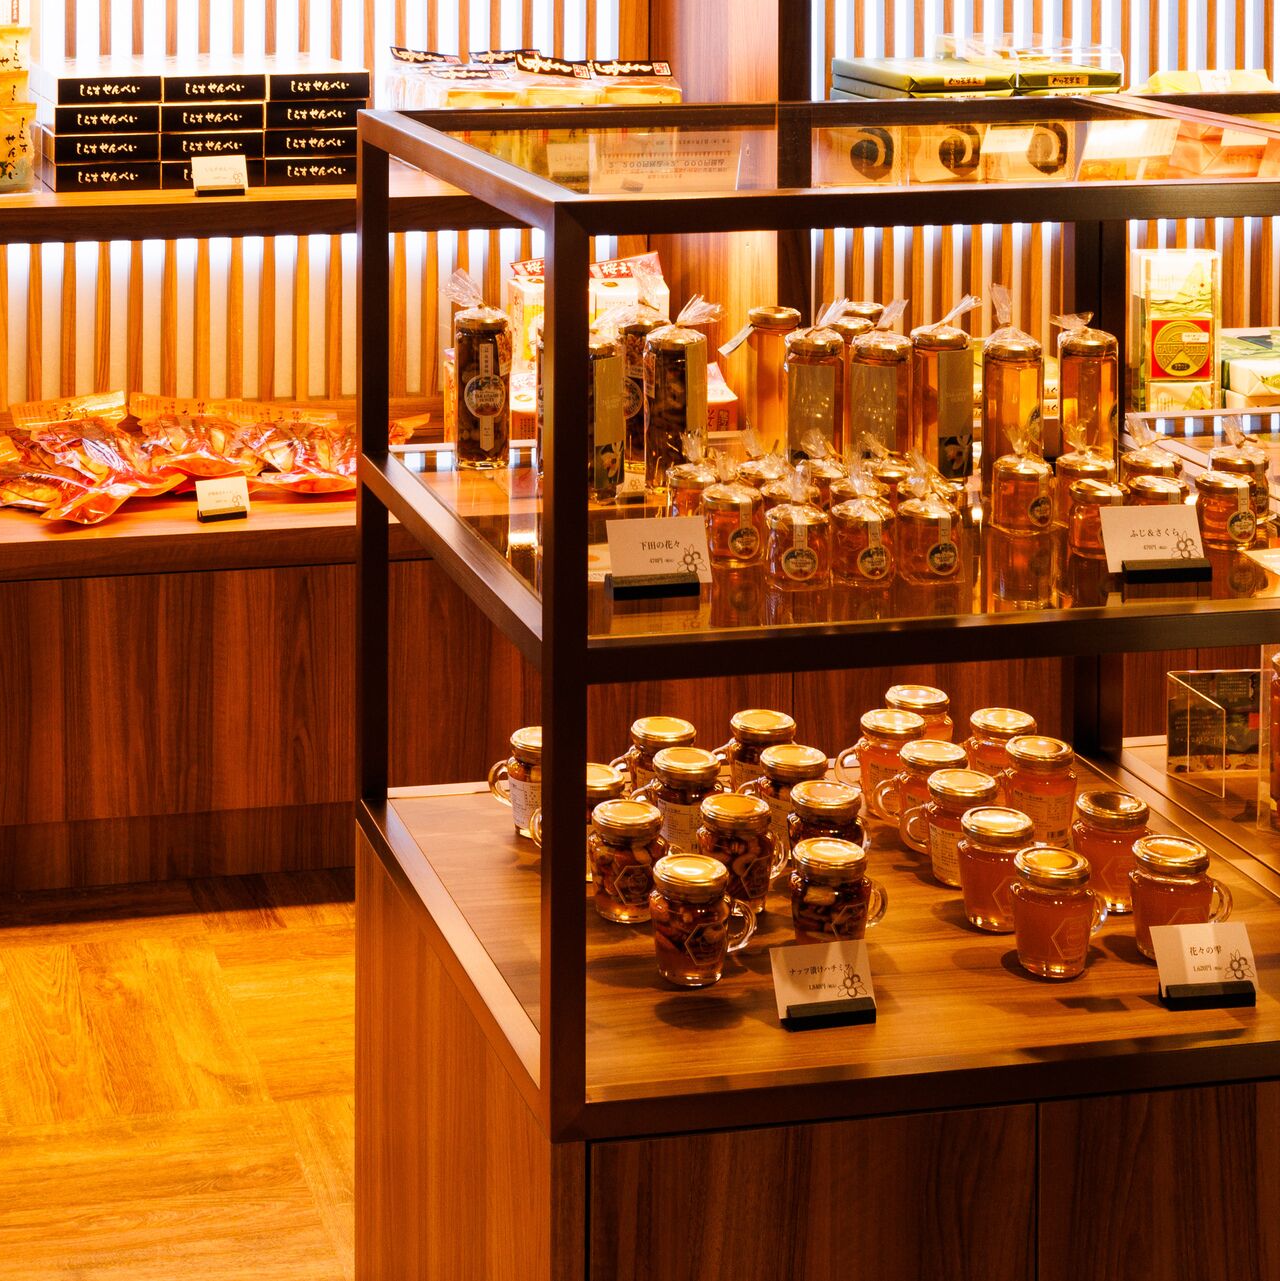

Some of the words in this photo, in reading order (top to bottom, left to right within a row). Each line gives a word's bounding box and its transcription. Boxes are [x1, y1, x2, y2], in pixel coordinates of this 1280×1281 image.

[1130, 529, 1179, 538] ふじ&さくら
[640, 540, 679, 551] 下田の花々
[789, 964, 851, 975] ナッツ漬けハチミツ
